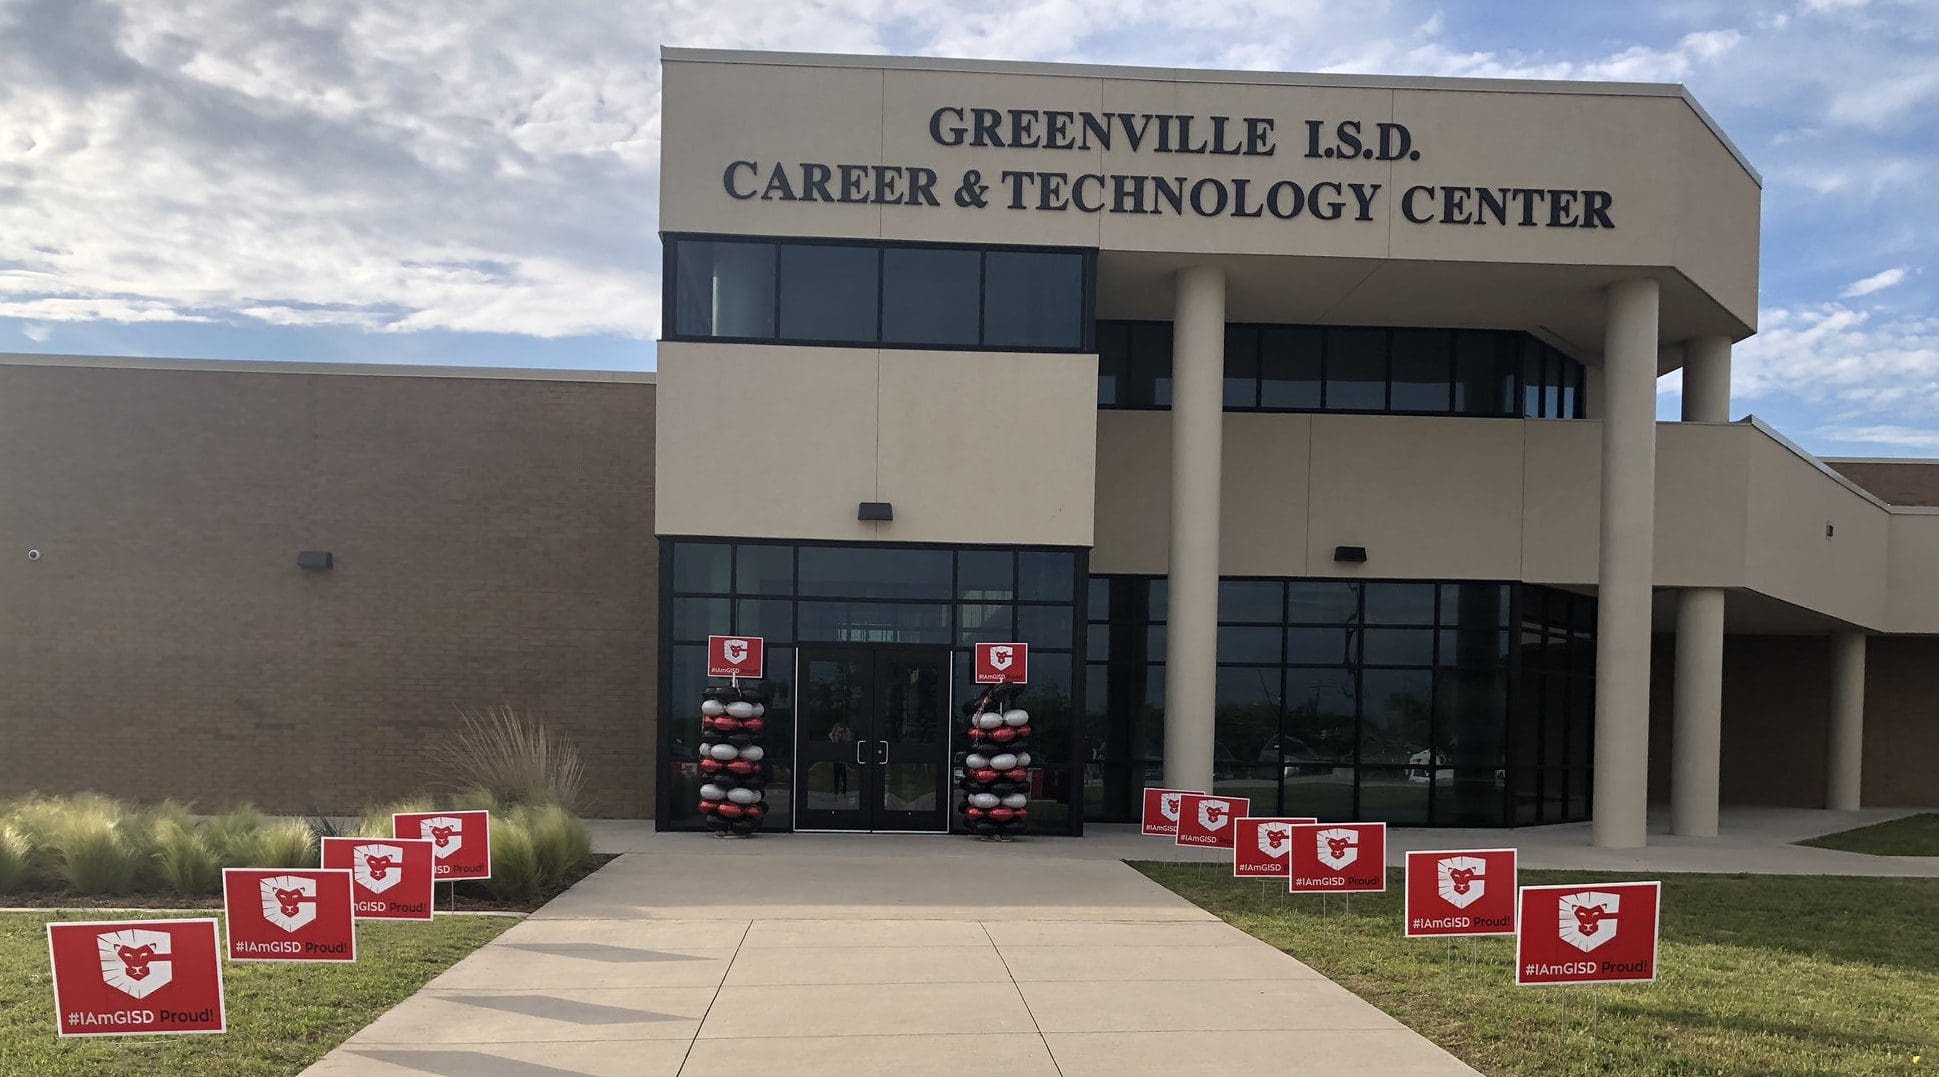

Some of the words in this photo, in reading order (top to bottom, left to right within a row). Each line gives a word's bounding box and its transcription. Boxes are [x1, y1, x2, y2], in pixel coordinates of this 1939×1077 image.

[929, 106, 1277, 157] GREENVILLE
[1304, 119, 1421, 162] I.S.D.
[723, 160, 940, 207] CAREER
[954, 169, 989, 209] &
[1001, 169, 1382, 222] TECHNOLOGY
[1401, 184, 1615, 229] CENTER
[1180, 835, 1217, 844] #IAmGISD
[1239, 863, 1282, 872] #IAmGISD
[1296, 877, 1345, 887] #IAmGISD
[389, 902, 426, 913] Proud!
[1413, 917, 1470, 929] #IAmGISD
[1473, 915, 1510, 927] Proud!
[236, 941, 301, 953] #IAmGISD
[305, 942, 347, 953] Proud!
[1525, 962, 1597, 975] #IAmGISD
[1602, 960, 1648, 974] Proud!
[68, 1010, 154, 1026] #IAmGISD
[159, 1008, 214, 1023] Proud!
